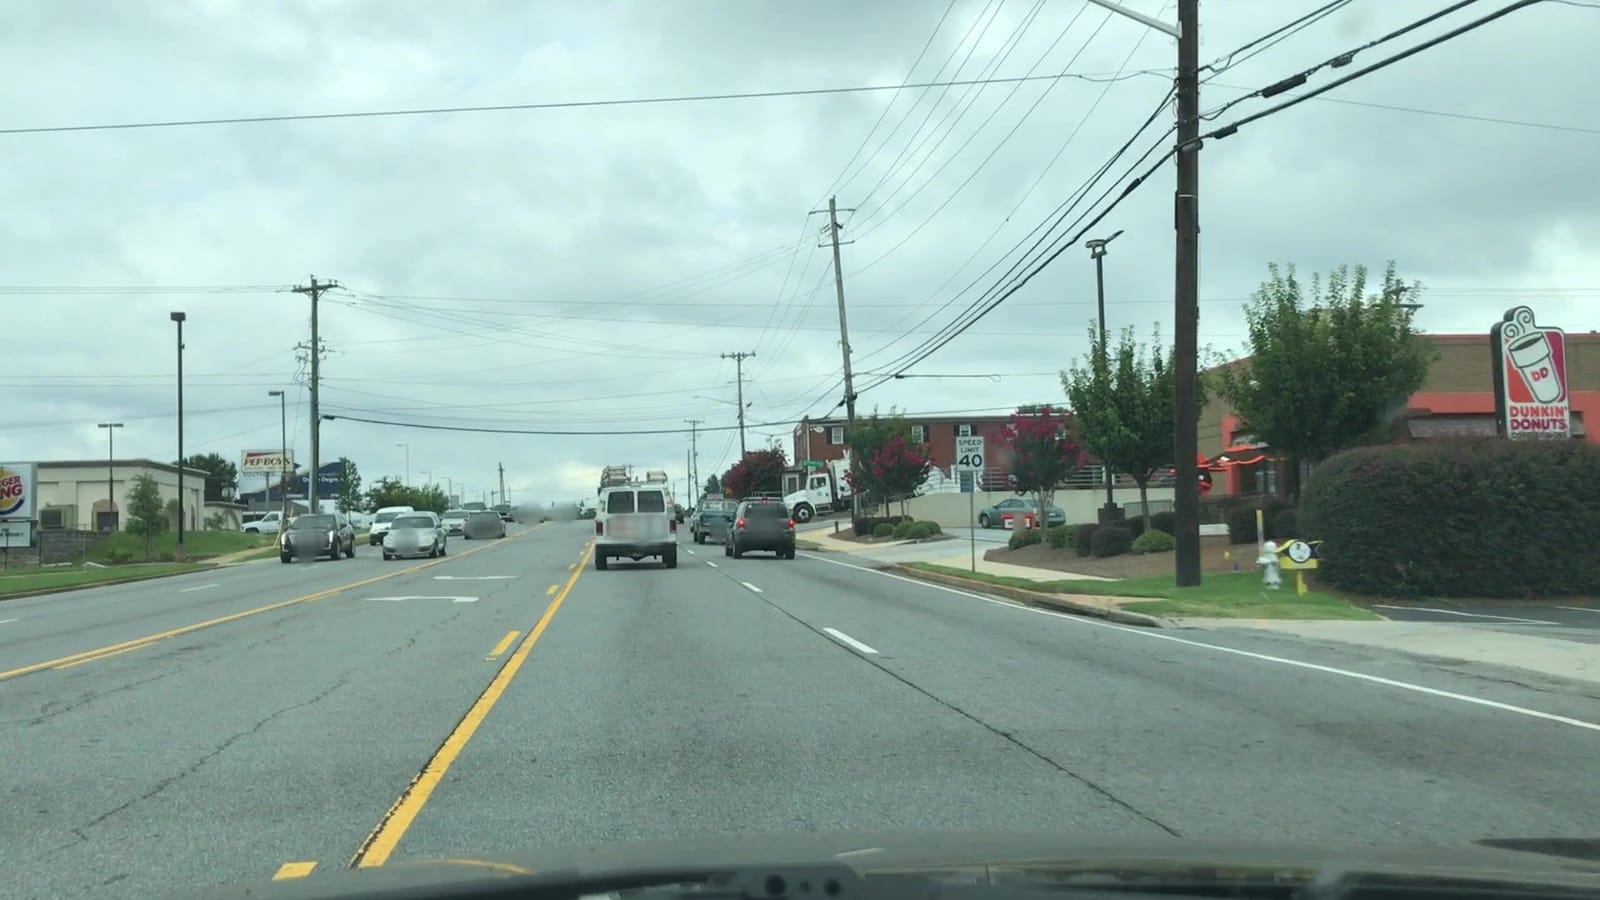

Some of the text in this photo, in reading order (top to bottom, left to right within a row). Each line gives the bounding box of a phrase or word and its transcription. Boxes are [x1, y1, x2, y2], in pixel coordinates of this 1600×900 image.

[1530, 367, 1548, 381] DD
[1509, 406, 1568, 418] DUNKIN'
[1510, 418, 1568, 430] DONUTS
[958, 454, 982, 467] 40
[0, 475, 21, 487] GER
